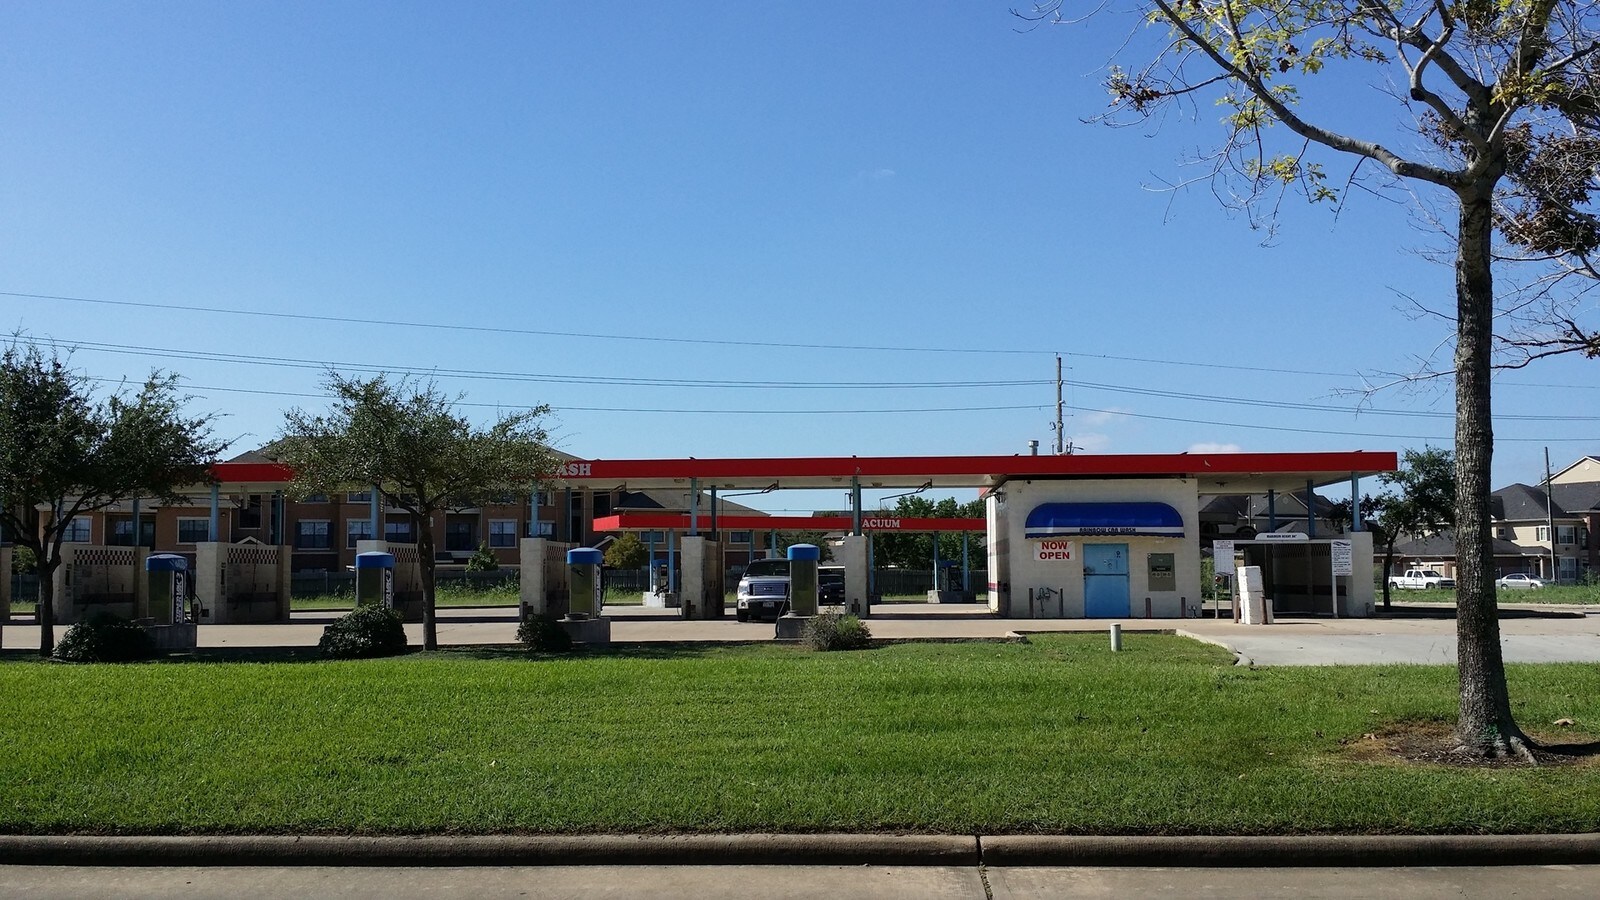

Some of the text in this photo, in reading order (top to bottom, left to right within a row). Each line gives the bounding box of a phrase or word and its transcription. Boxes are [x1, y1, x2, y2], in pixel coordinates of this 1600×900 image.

[556, 463, 592, 476] ASH
[861, 518, 900, 528] ACUUM
[1041, 541, 1068, 550] NOW
[1039, 551, 1070, 560] OPEN
